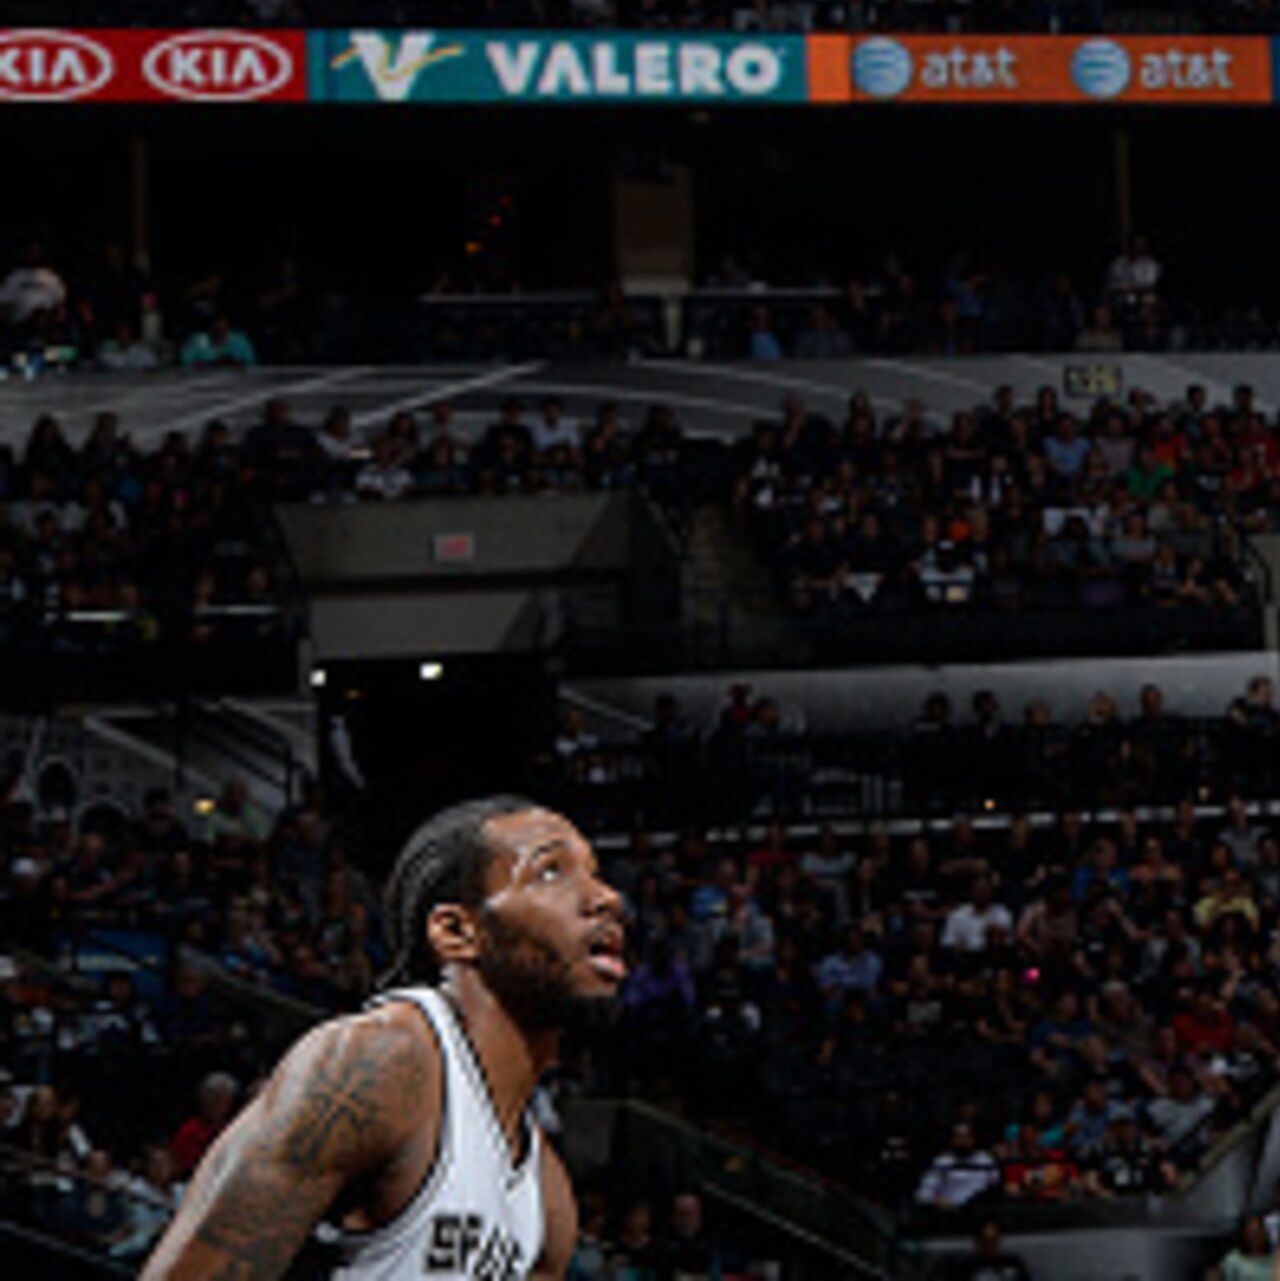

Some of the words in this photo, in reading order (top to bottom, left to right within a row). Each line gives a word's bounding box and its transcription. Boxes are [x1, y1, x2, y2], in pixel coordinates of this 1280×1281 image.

[168, 46, 272, 86] KIA
[486, 41, 784, 96] VALERO
[919, 45, 1020, 90] at&t
[1140, 45, 1233, 90] at&t
